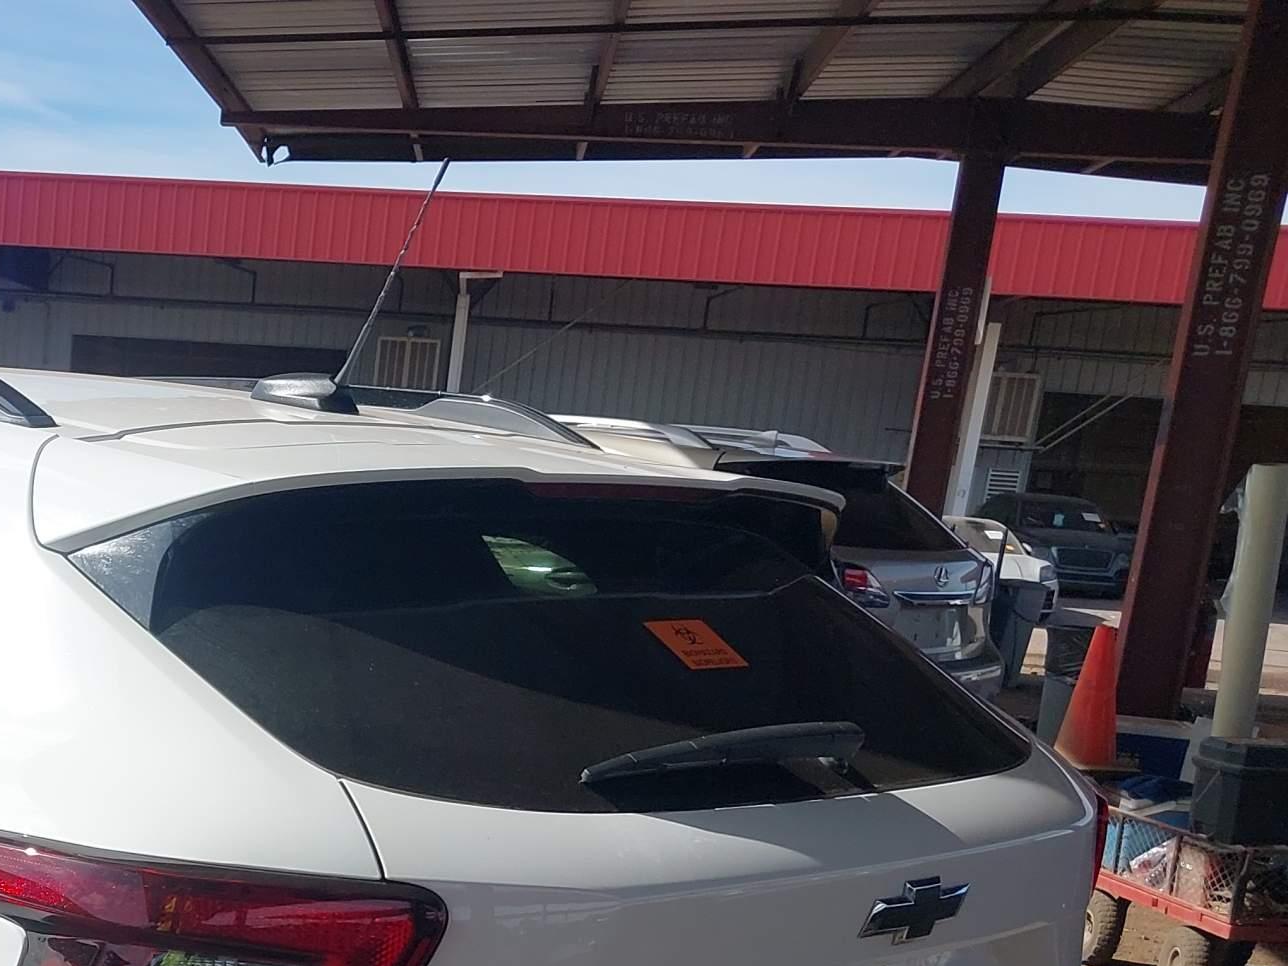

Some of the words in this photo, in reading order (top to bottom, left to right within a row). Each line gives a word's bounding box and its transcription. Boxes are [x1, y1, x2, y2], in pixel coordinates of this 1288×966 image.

[1203, 224, 1234, 305] PREFAB
[1216, 174, 1271, 355] 1-866-799-0969
[935, 318, 954, 367] PREFAB
[1193, 317, 1216, 356] U.S.
